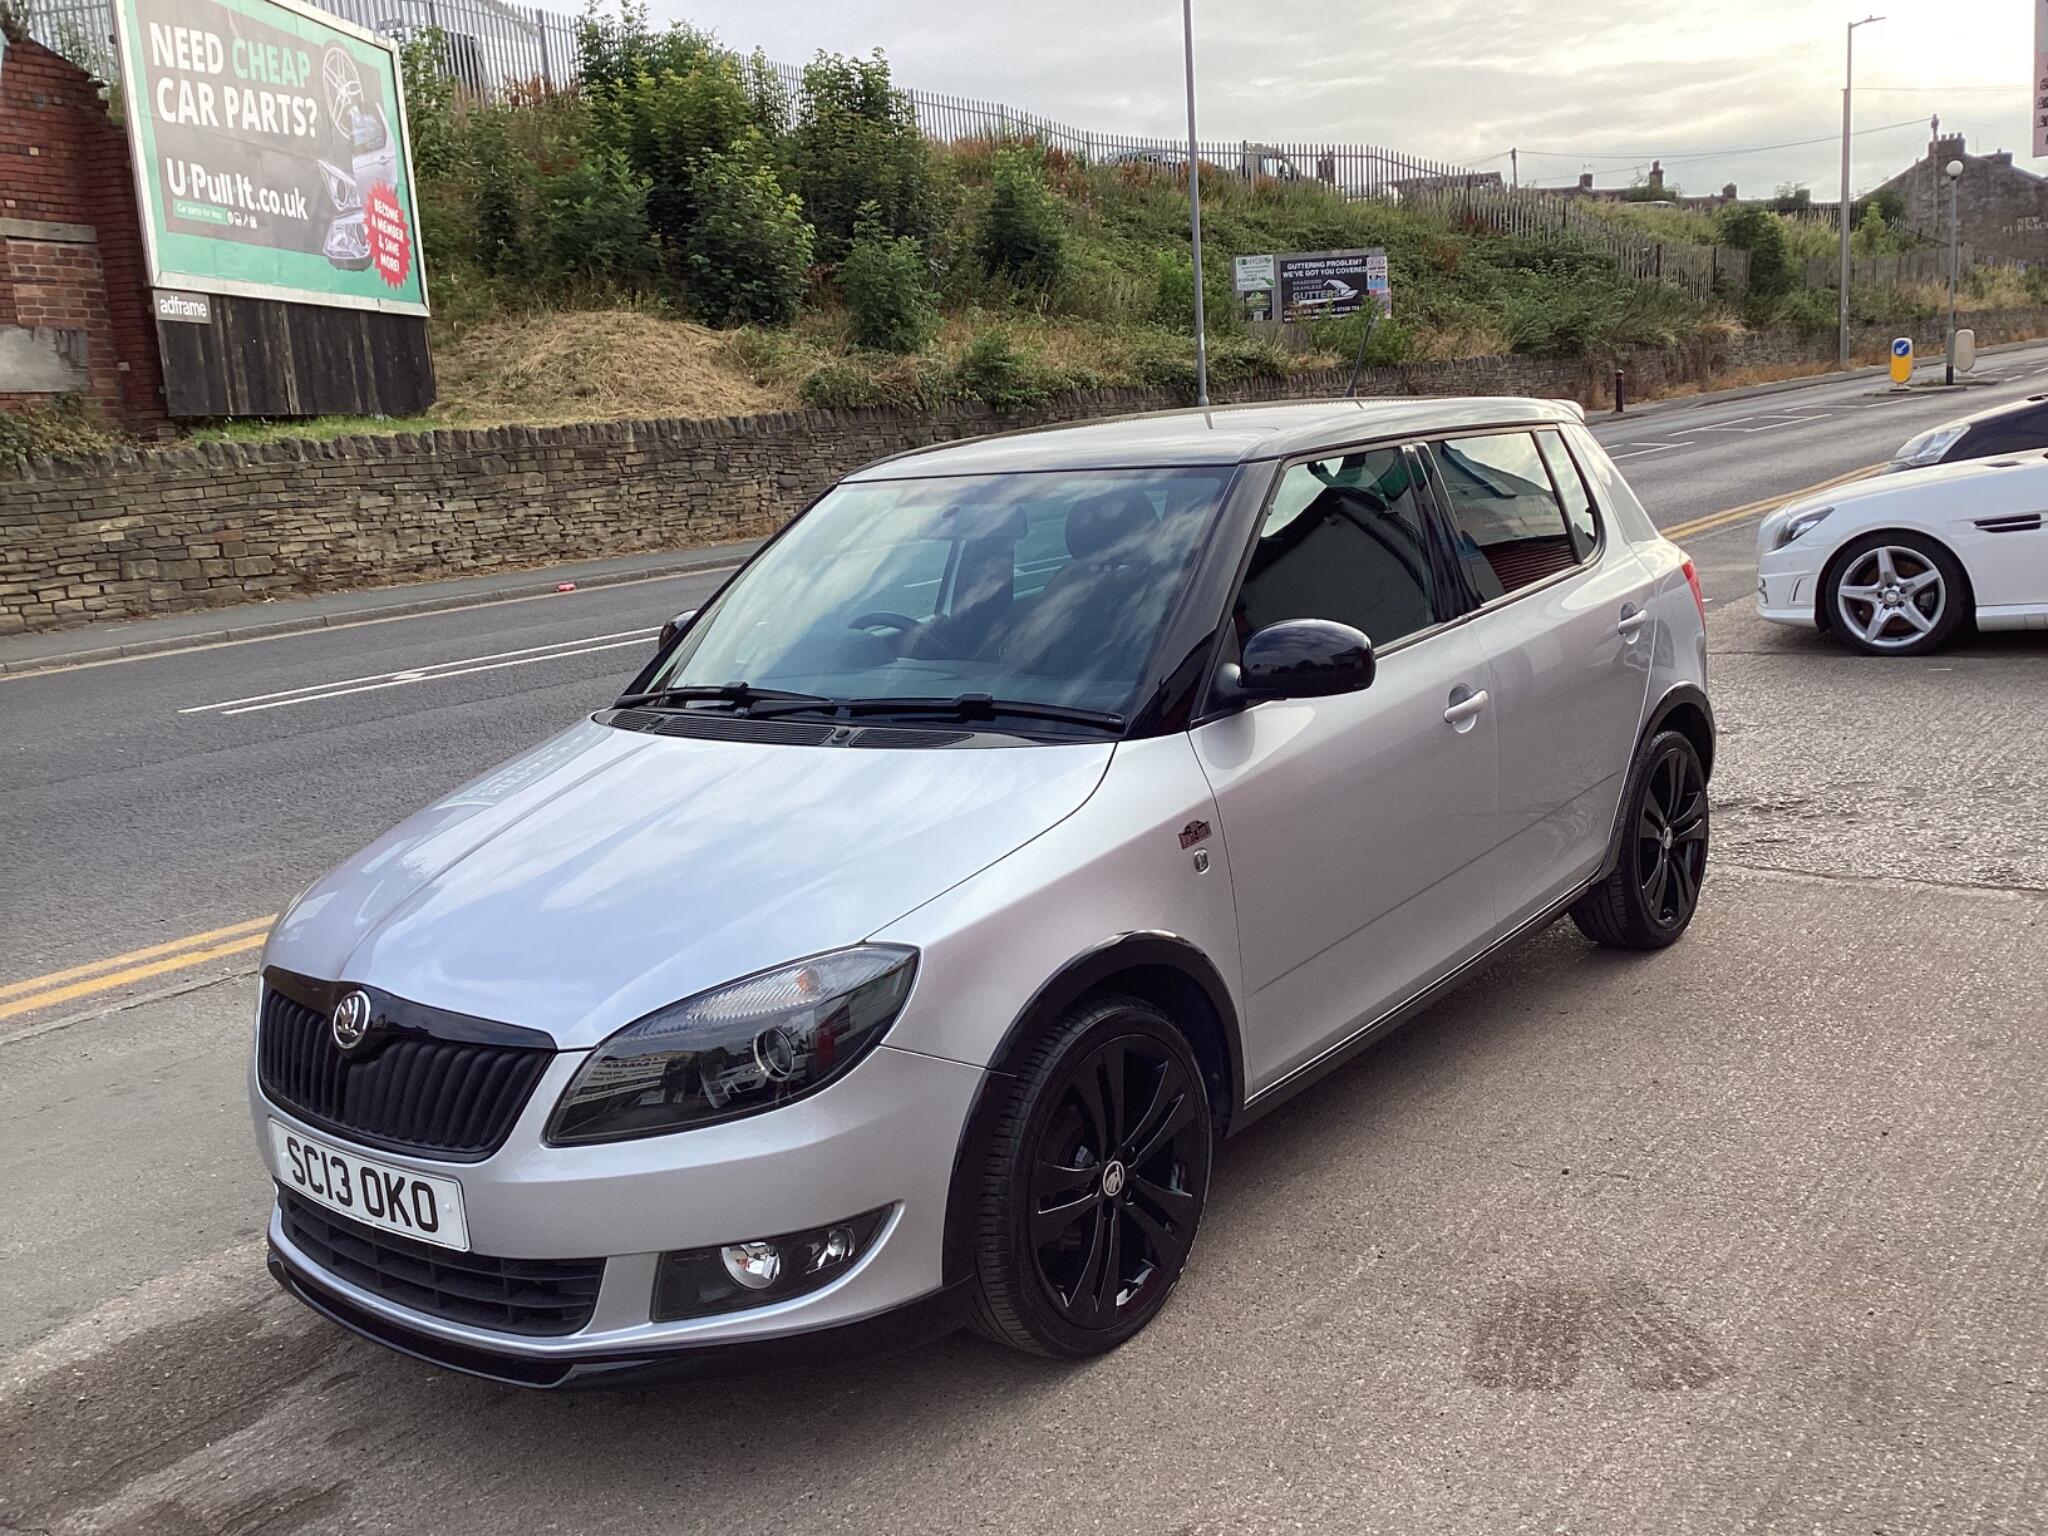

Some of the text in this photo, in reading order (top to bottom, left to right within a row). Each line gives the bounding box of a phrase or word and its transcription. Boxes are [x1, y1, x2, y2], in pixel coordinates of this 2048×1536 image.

[149, 22, 311, 88] NEED CHEAP
[156, 77, 318, 138] CAR PARTS?
[373, 198, 400, 224] BECOME
[377, 216, 404, 244] MEMBER
[384, 237, 400, 257] SAVE
[1282, 270, 1304, 278] WE'VE
[1305, 269, 1319, 277] GOT
[1336, 266, 1368, 274] COVERED
[1287, 261, 1325, 270] GUTTERING
[1326, 258, 1363, 267] PROBLEM?
[160, 295, 208, 318] adframe
[1293, 289, 1340, 300] GUTTERS
[286, 1136, 353, 1208] SC13
